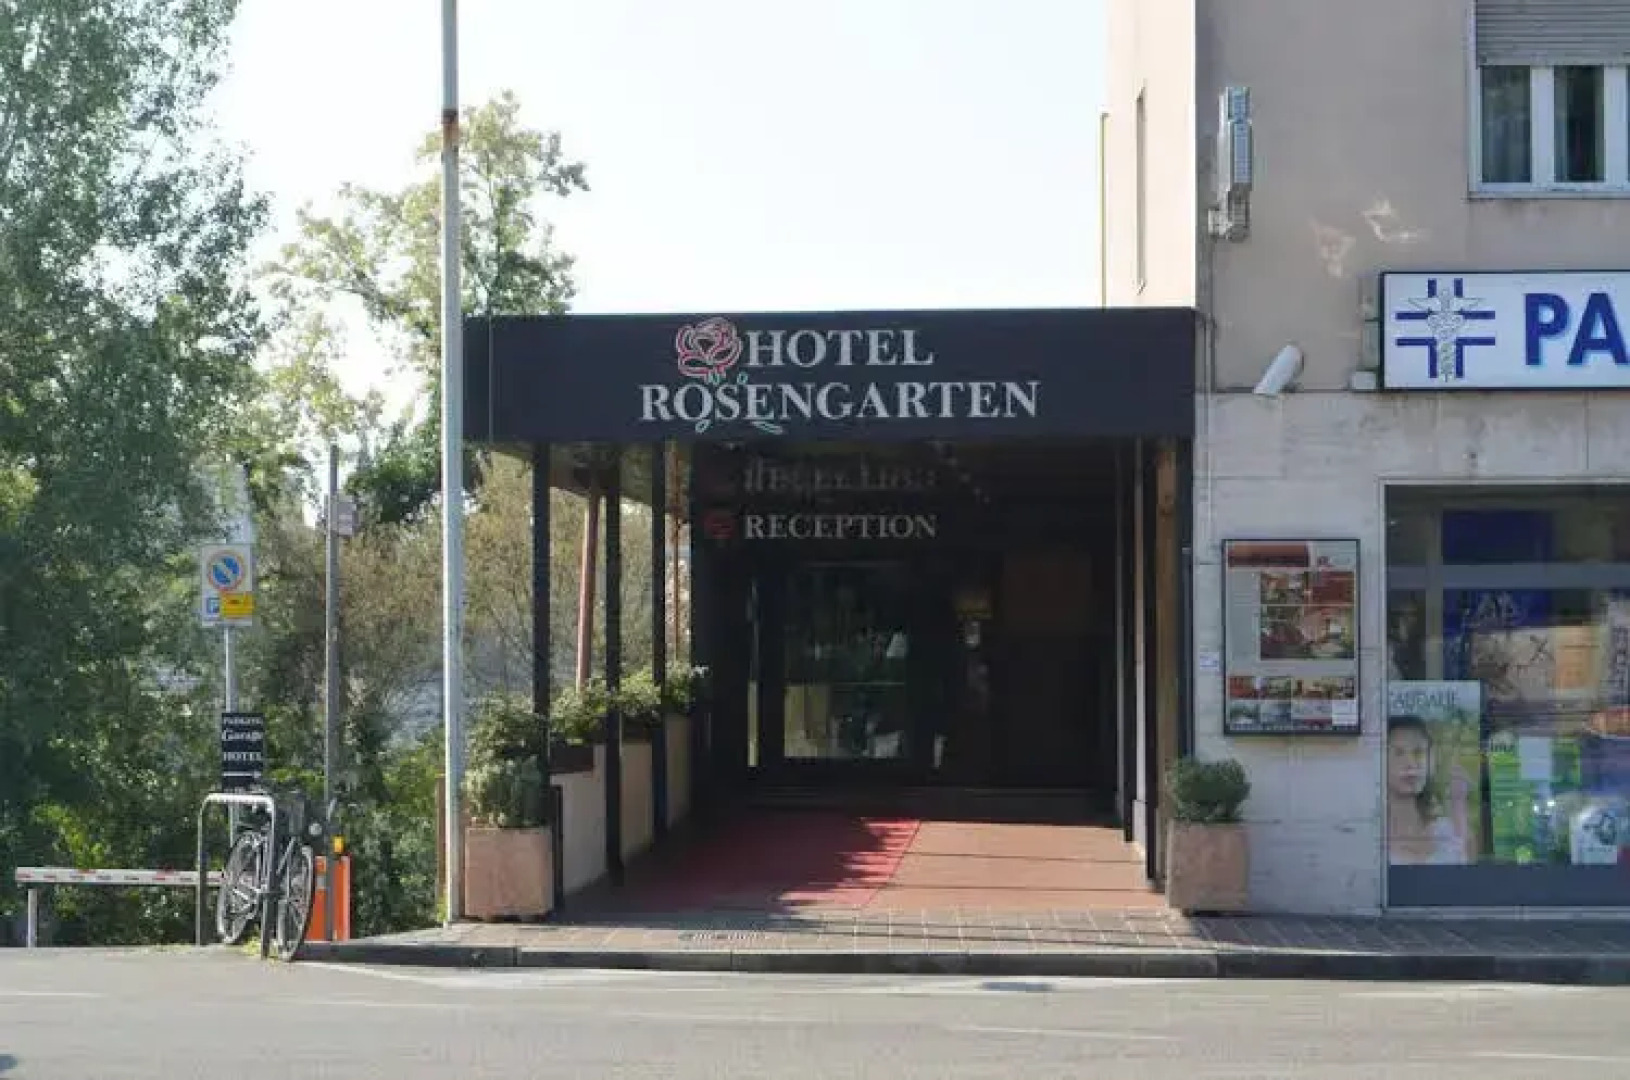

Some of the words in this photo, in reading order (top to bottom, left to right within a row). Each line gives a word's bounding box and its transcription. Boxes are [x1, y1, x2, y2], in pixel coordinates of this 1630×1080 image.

[744, 329, 934, 367] HOTEL
[1525, 292, 1630, 366] PA
[640, 381, 1041, 422] ROSENGARTEN
[744, 514, 937, 540] RECEPTION
[223, 751, 262, 763] HOTEL
